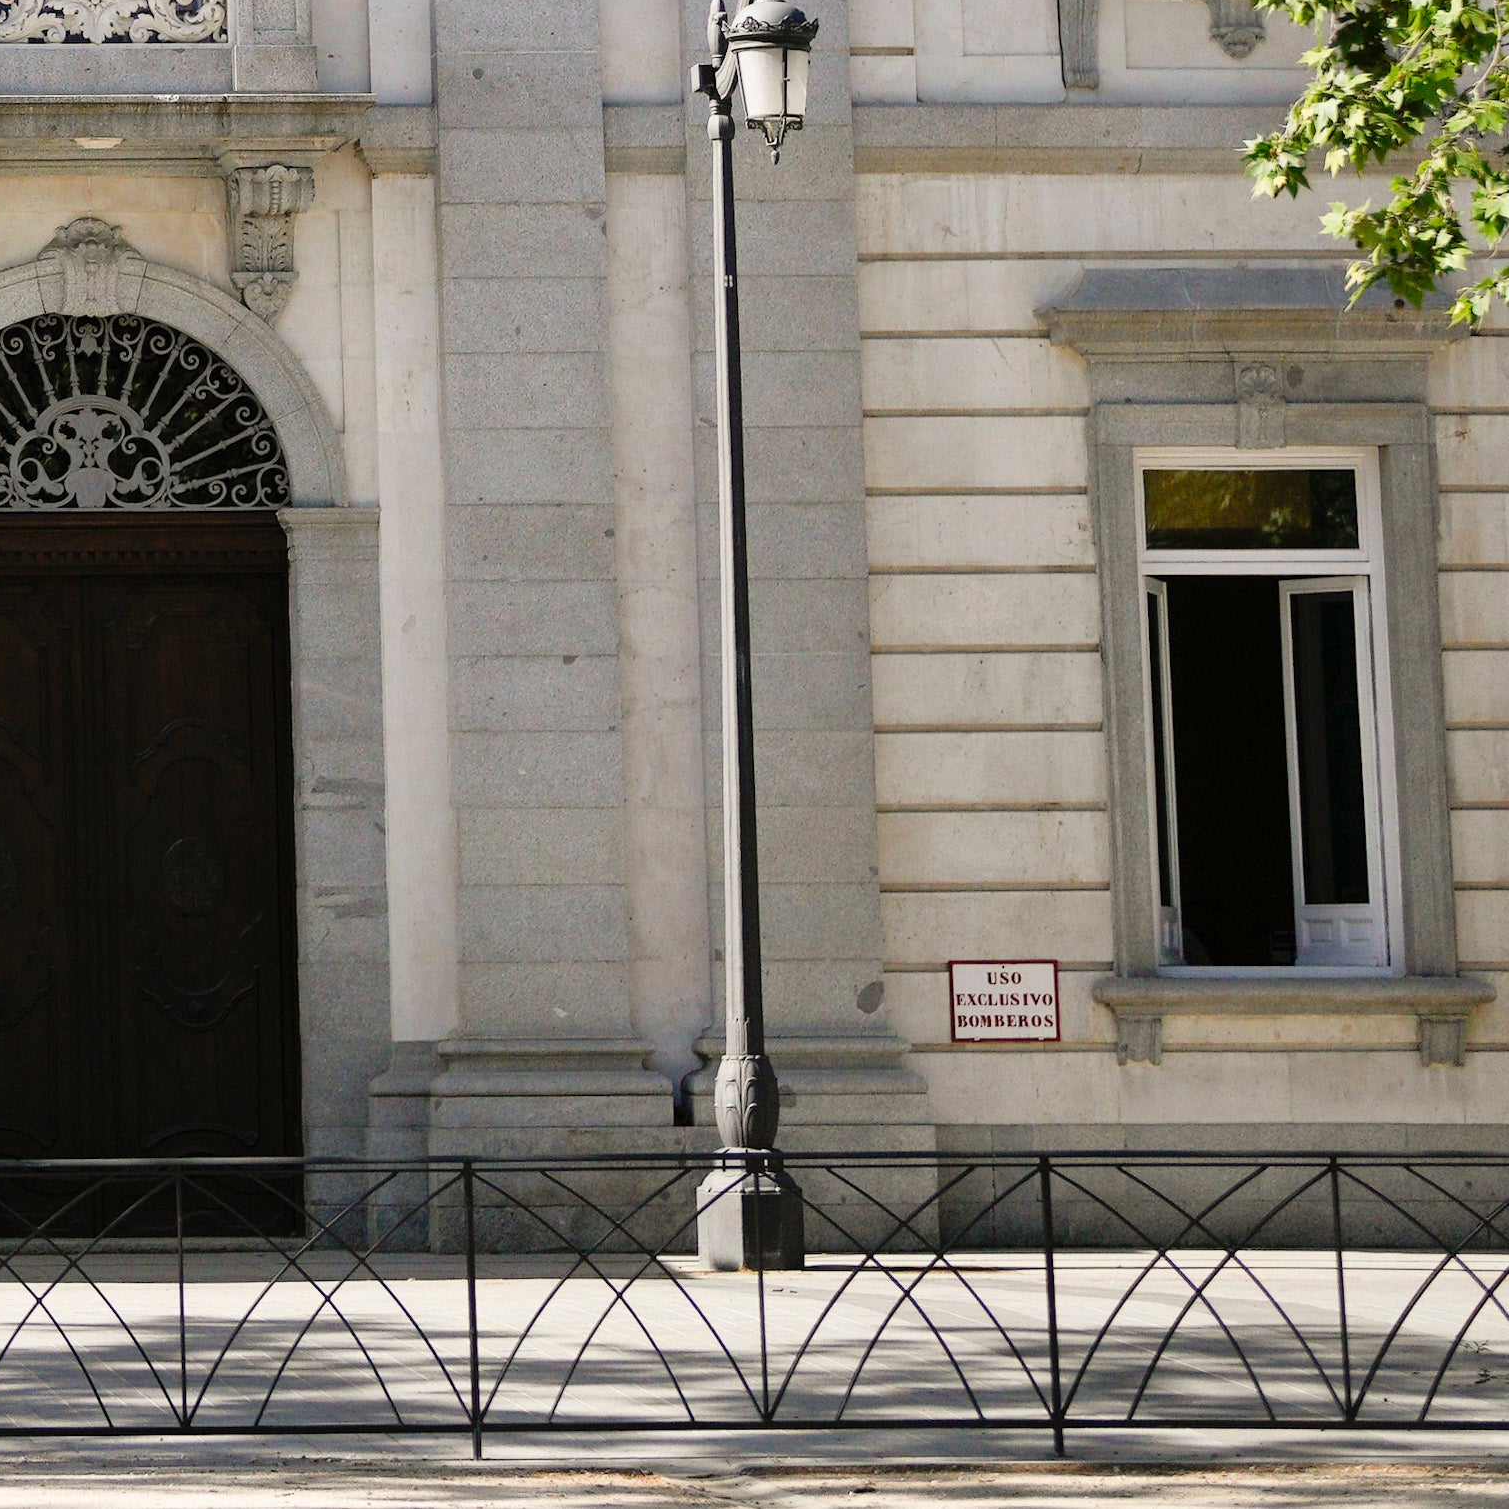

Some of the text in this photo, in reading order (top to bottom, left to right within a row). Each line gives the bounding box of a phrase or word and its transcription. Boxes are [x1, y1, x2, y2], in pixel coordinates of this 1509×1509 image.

[986, 971, 1023, 986] USO
[955, 992, 1054, 1007] EXCLUSIVO
[957, 1014, 1055, 1028] BOMBEROS
